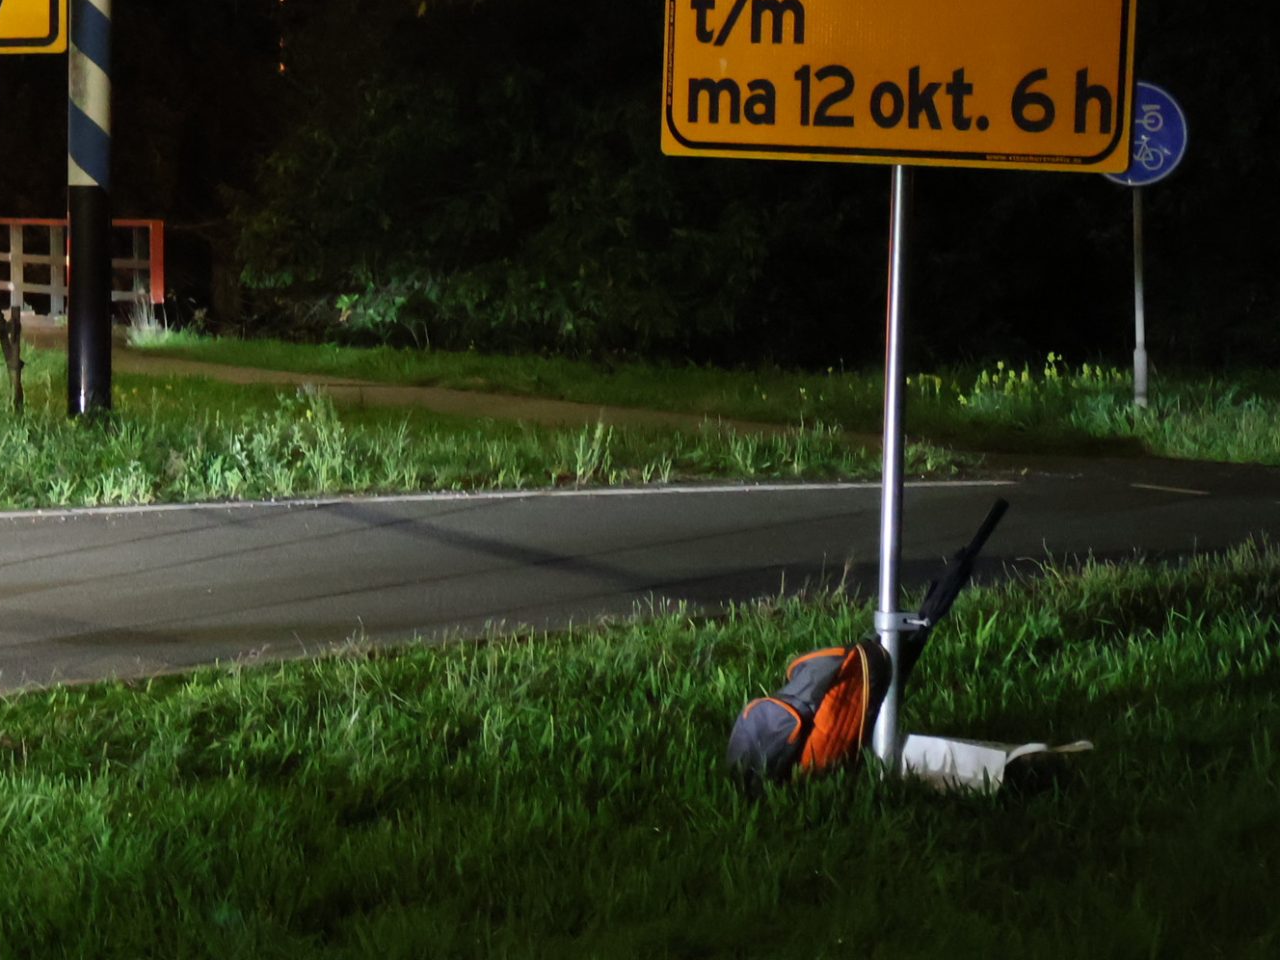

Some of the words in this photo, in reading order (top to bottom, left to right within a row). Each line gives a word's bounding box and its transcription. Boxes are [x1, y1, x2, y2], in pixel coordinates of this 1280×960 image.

[687, 75, 776, 126] ma
[794, 63, 854, 127] 12
[870, 64, 990, 131] okt.
[1011, 68, 1055, 133] 6
[1073, 67, 1112, 134] h
